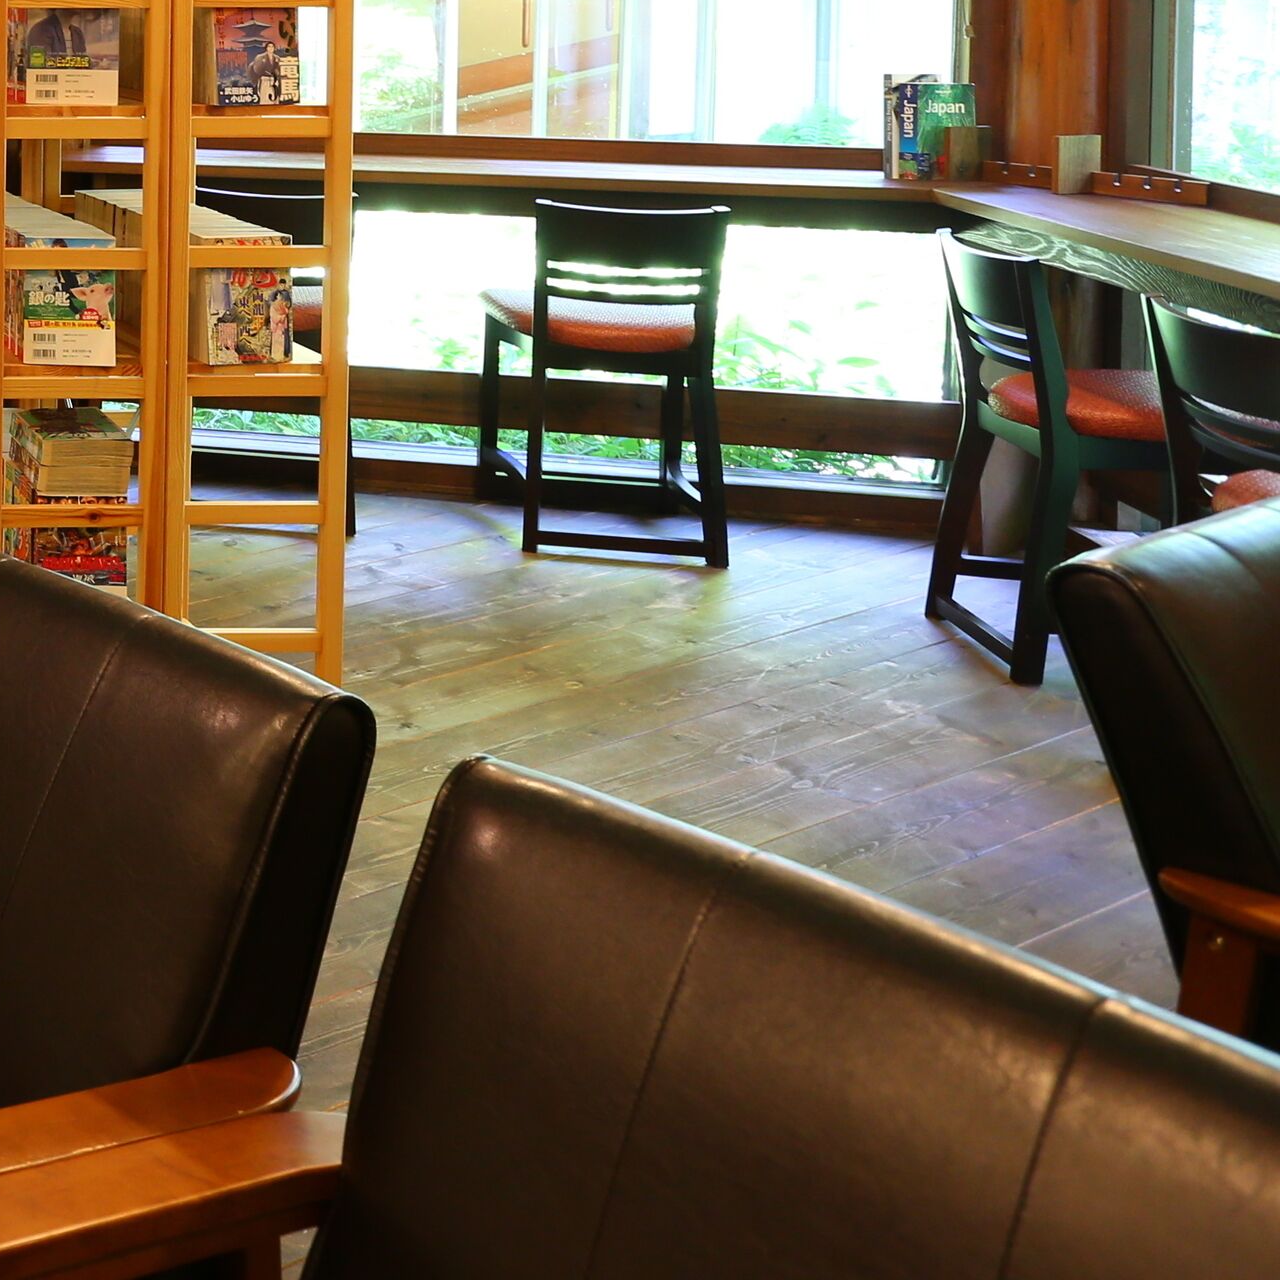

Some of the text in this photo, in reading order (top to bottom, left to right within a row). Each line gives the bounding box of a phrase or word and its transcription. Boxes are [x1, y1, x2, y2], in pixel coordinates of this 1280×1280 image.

[925, 99, 965, 116] Japan
[900, 100, 918, 138] Japan
[28, 290, 71, 307] 銀の匙
